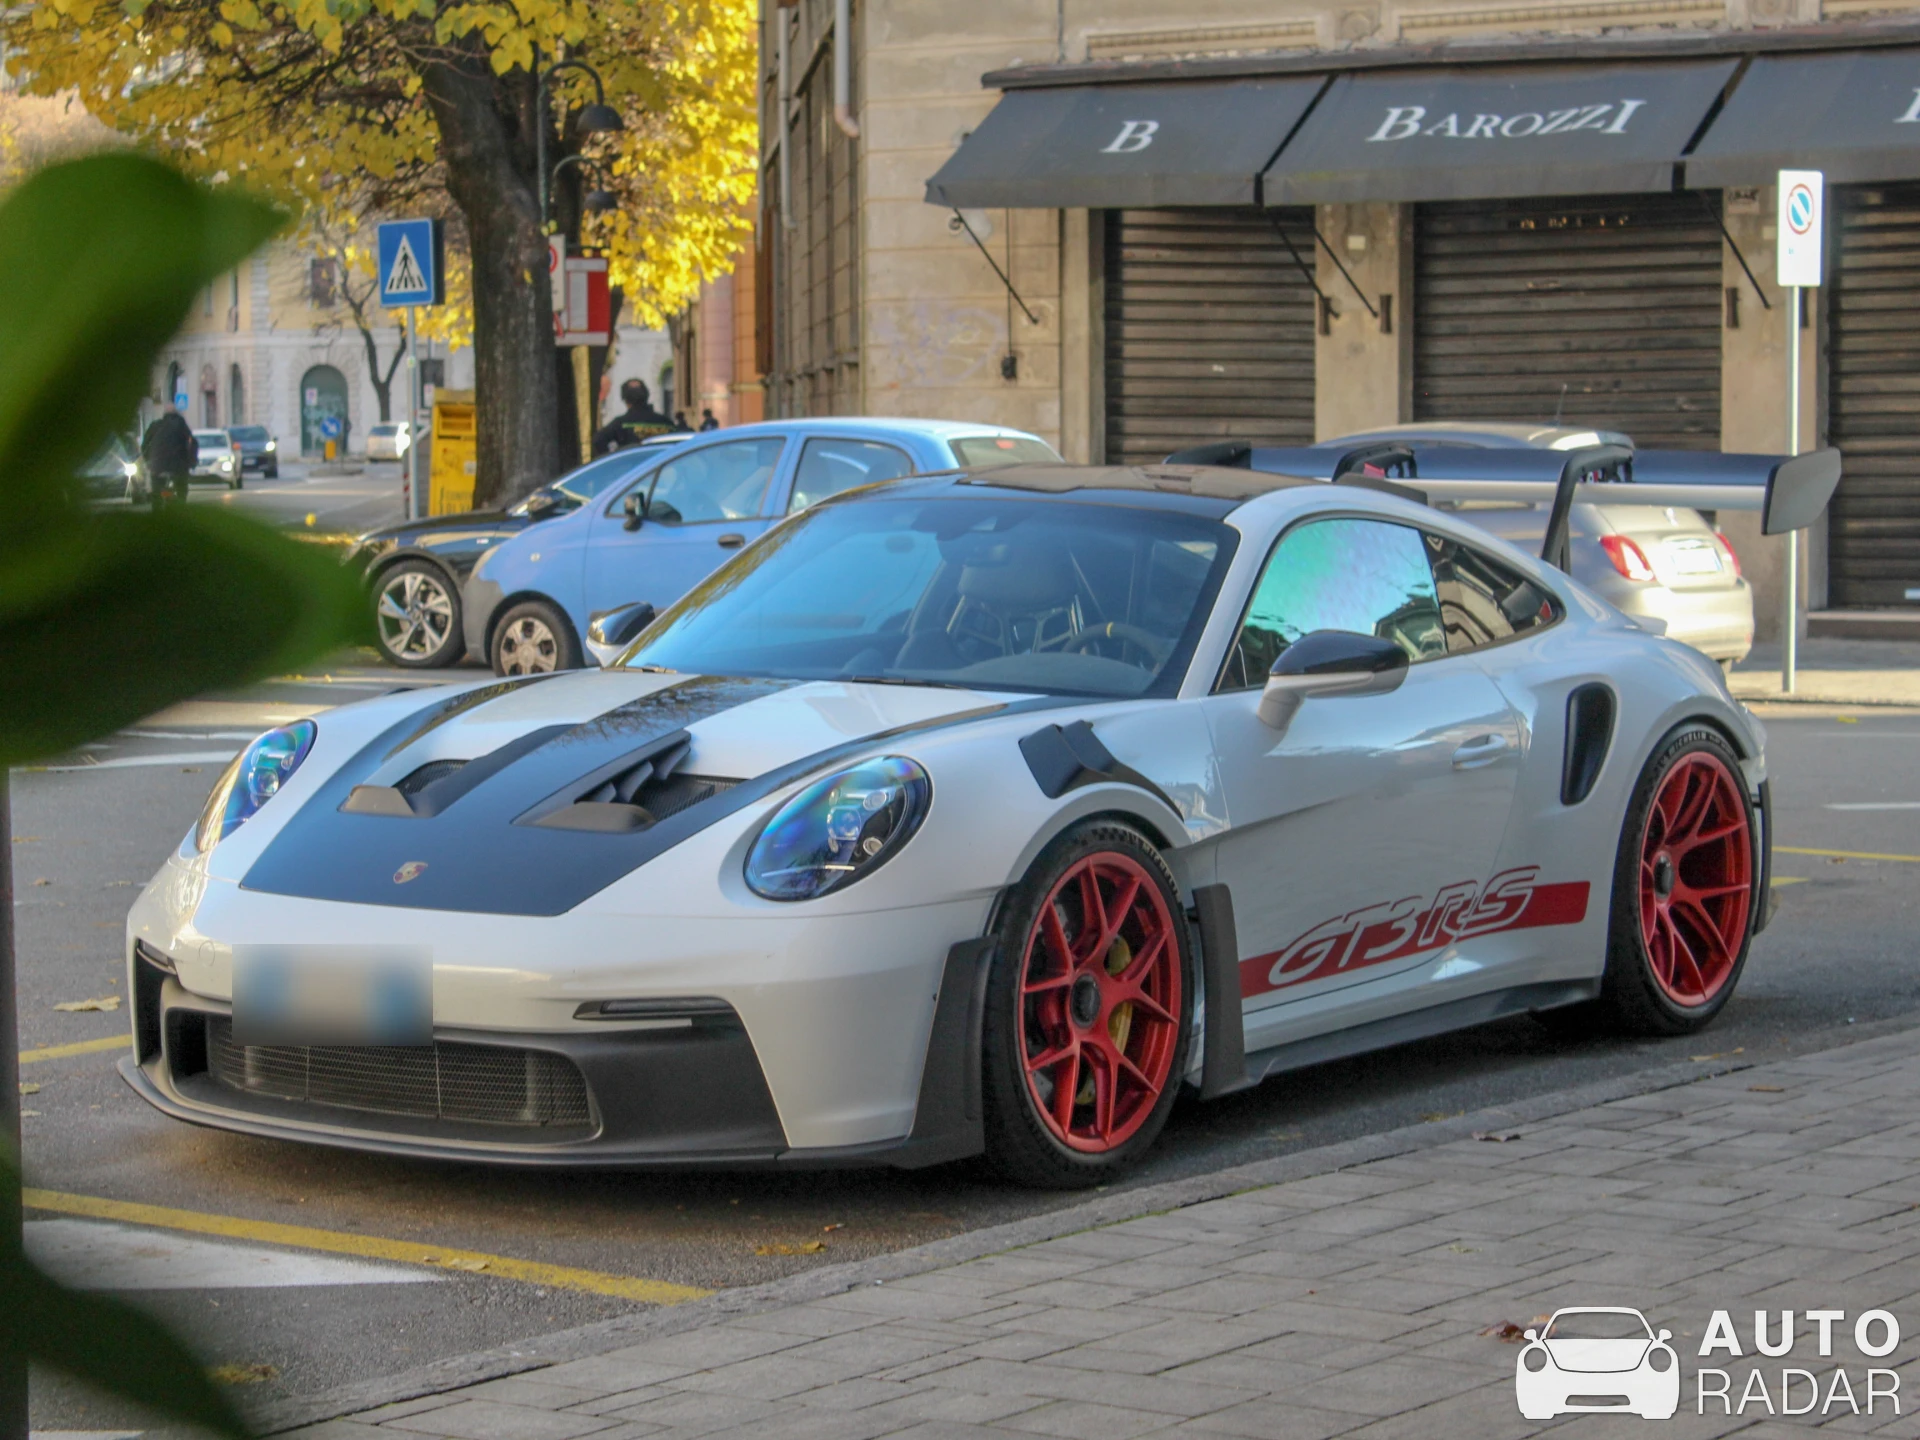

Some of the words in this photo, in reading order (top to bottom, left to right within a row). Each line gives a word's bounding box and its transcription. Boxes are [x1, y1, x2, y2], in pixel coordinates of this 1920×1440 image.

[1100, 119, 1160, 153] B
[1365, 99, 1647, 142] BAROZZI
[1669, 731, 1707, 757] MICHELIN
